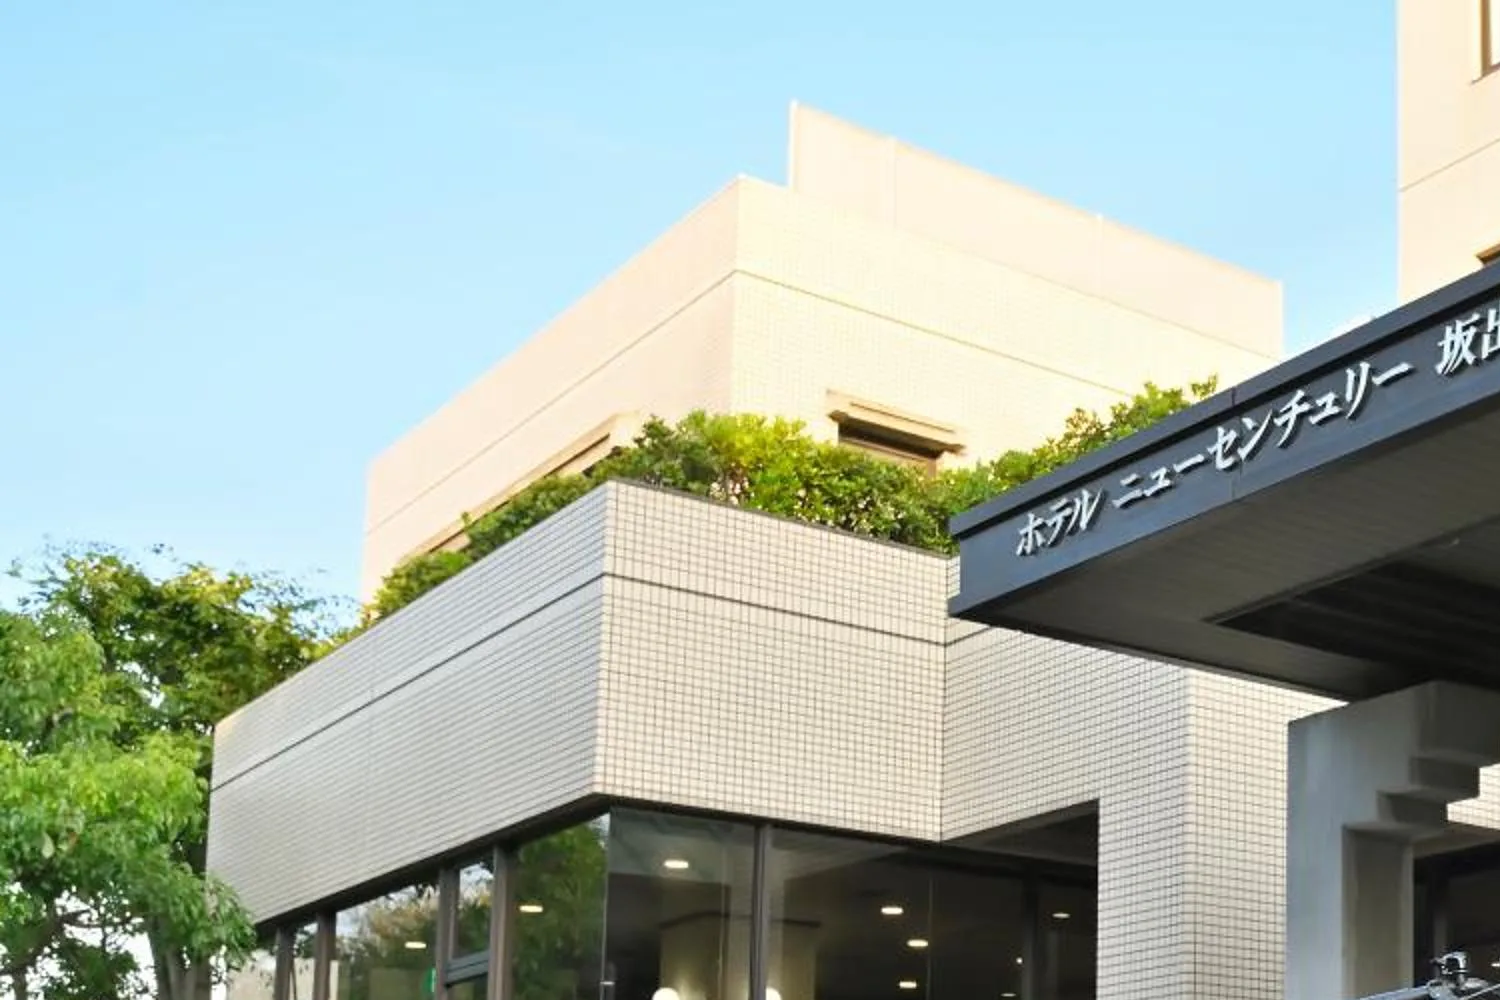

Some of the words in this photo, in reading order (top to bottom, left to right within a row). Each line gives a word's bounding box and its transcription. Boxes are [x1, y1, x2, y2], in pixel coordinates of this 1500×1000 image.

[1016, 488, 1101, 556] ホテル
[1113, 361, 1414, 508] ニューセンチュリー
